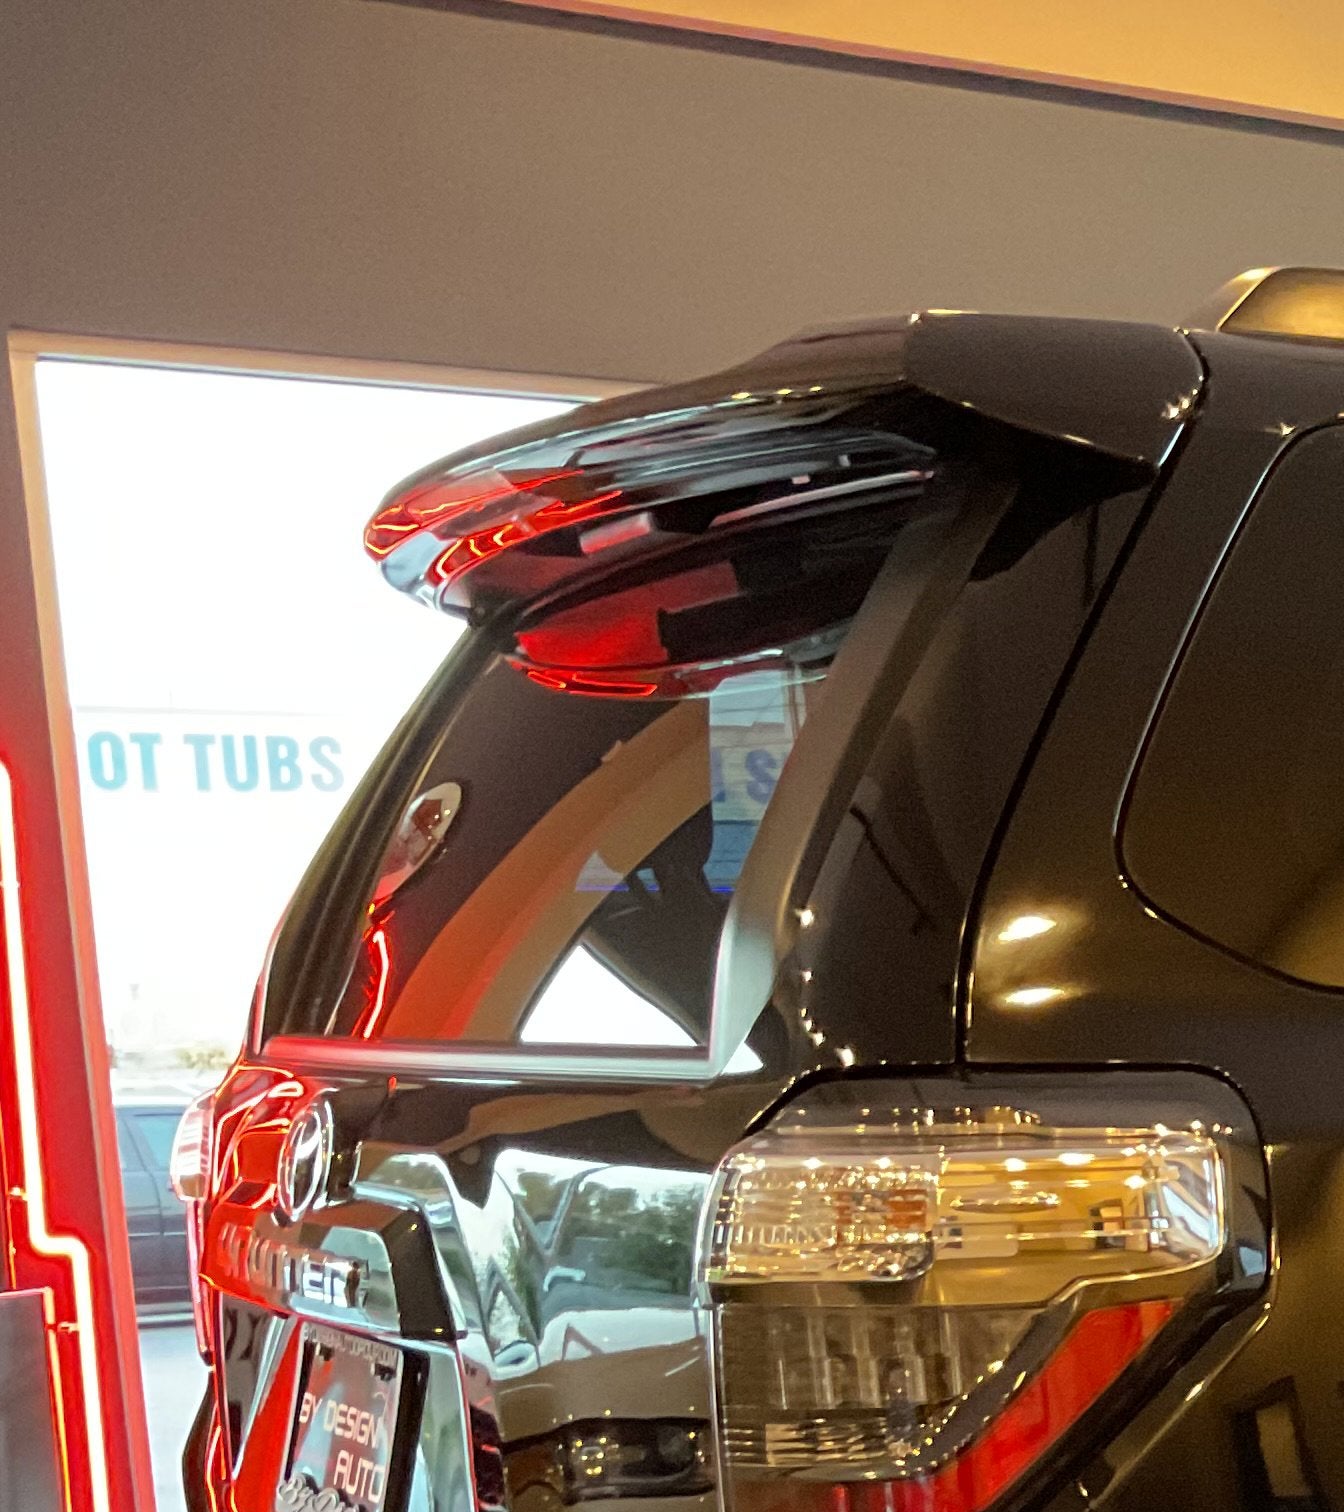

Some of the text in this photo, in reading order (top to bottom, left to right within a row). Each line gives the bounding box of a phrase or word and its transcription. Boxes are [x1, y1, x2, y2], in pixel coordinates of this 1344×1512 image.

[87, 731, 345, 792] OT TUBS
[299, 1391, 382, 1449] BY DESIGN
[333, 1449, 386, 1504] AUTO
